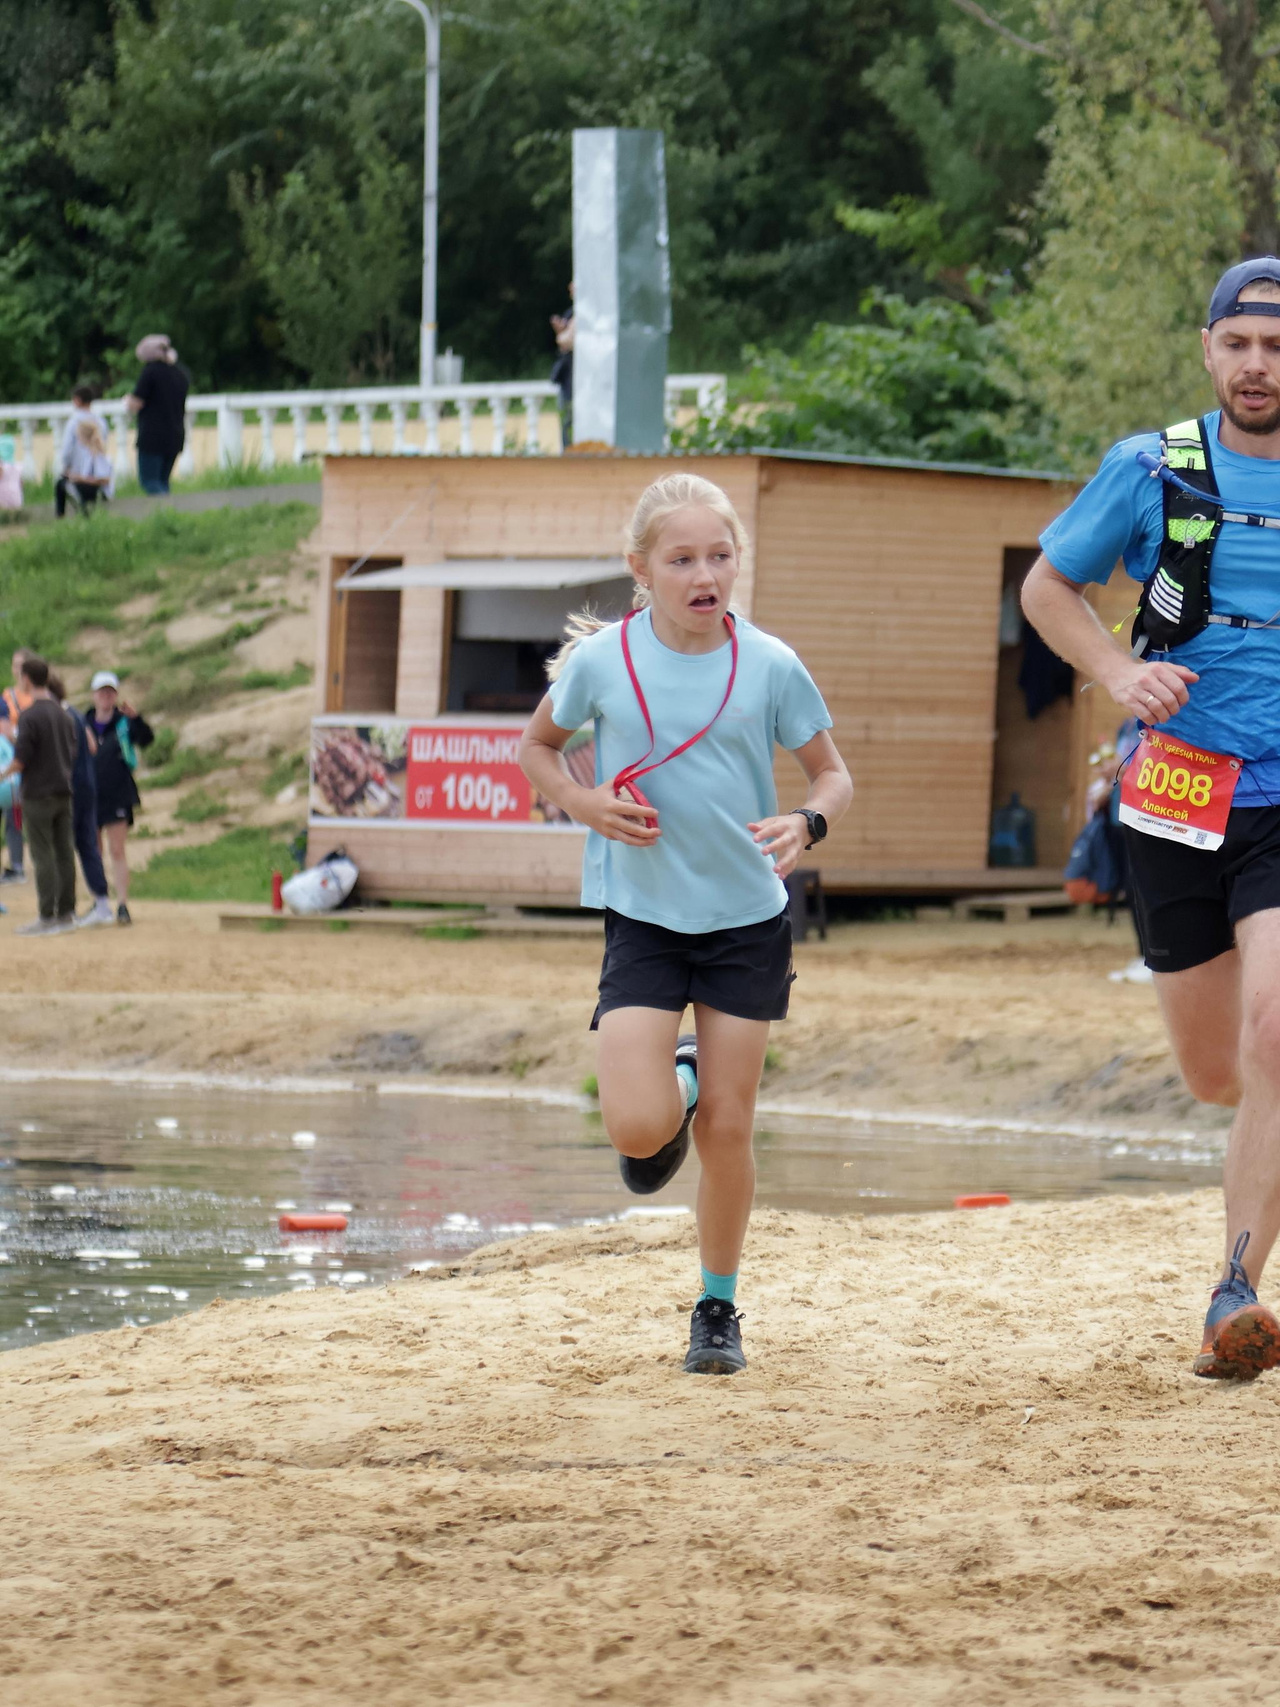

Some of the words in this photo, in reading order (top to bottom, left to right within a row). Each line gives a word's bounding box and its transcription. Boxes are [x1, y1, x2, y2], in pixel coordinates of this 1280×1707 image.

[1164, 743, 1193, 761] UGRESHA
[1194, 752, 1218, 765] TRAIL
[441, 773, 518, 819] 100р.
[1136, 757, 1213, 807] 6098
[1141, 799, 1189, 821] Алексей
